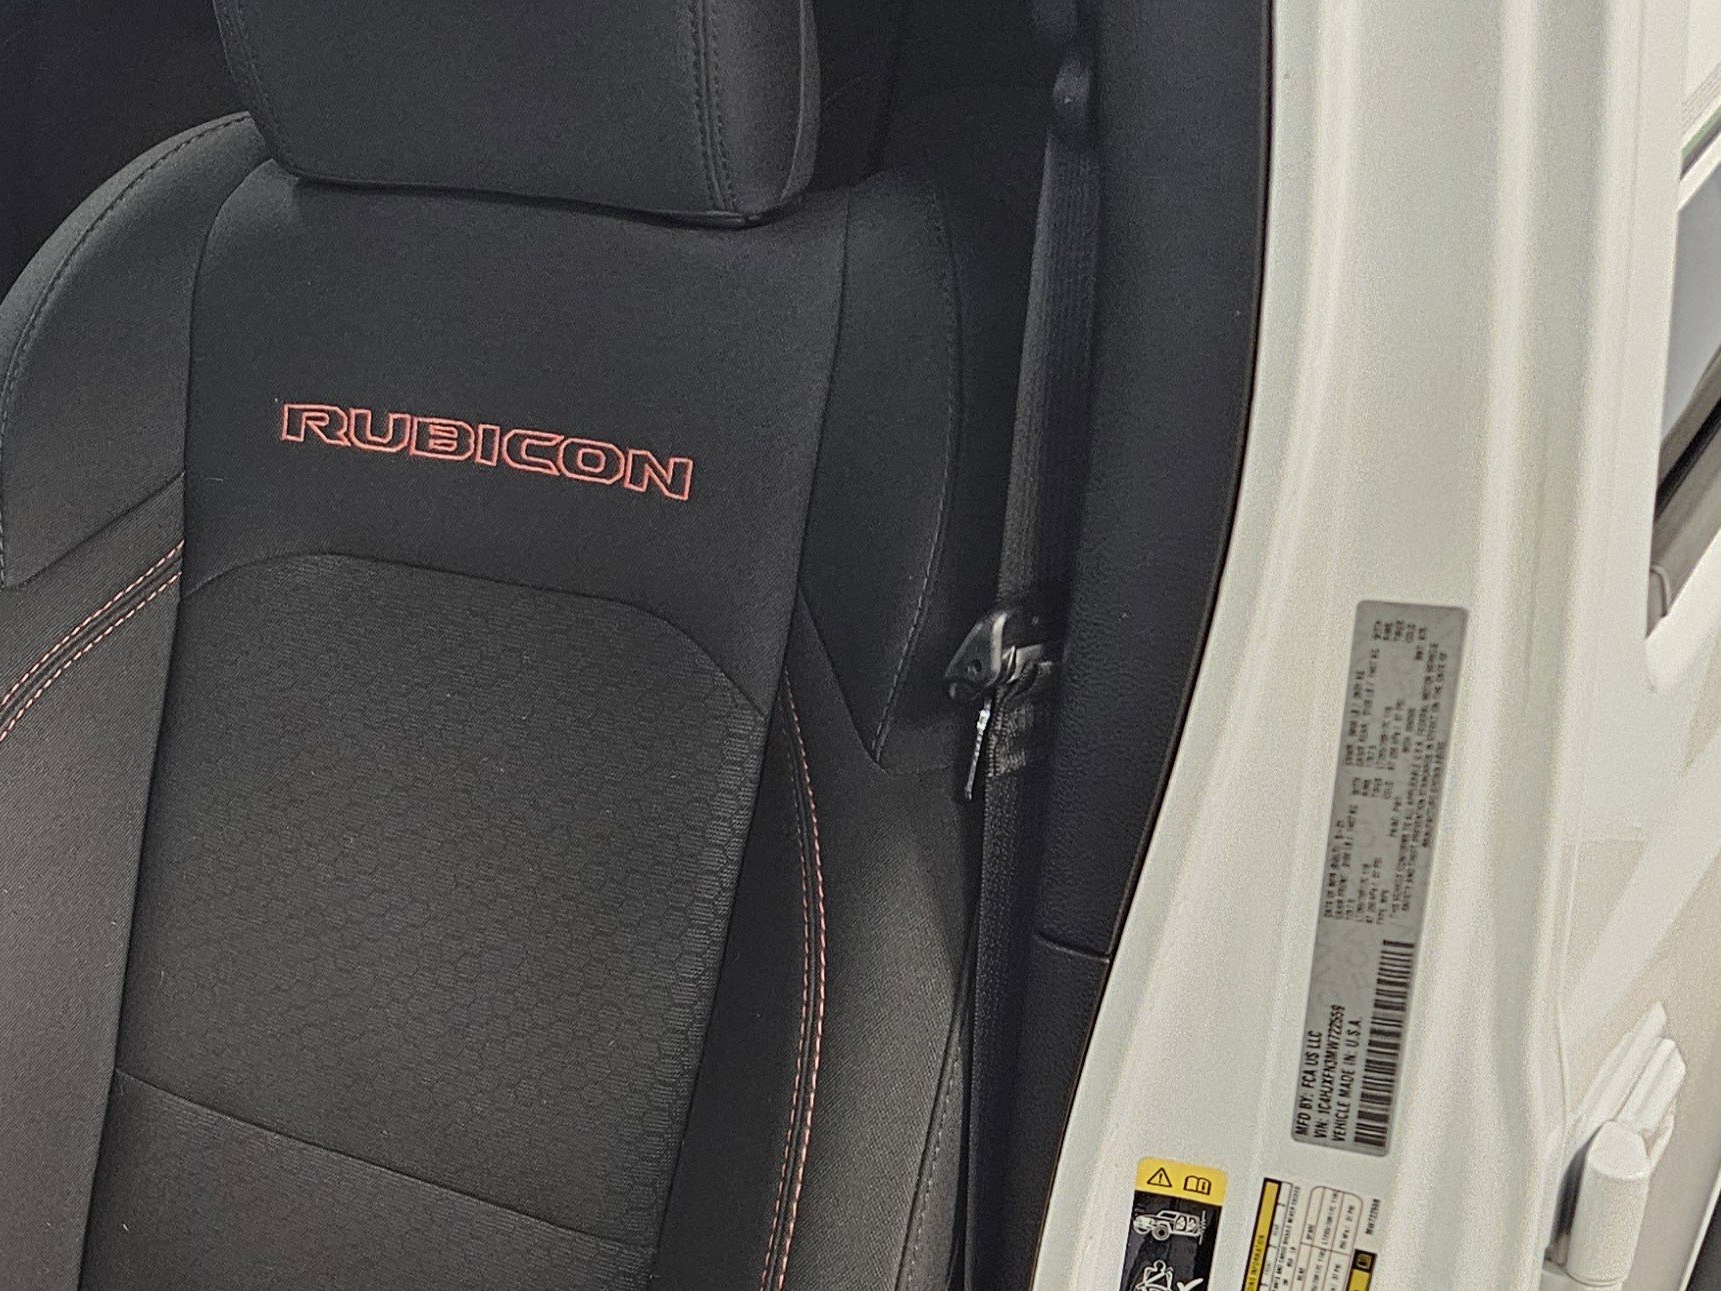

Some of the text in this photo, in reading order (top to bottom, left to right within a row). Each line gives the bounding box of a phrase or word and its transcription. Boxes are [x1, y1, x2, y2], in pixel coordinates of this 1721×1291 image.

[281, 403, 694, 501] RUBICON
[1306, 1029, 1322, 1049] LLC
[1303, 1050, 1319, 1066] US
[1300, 1067, 1317, 1089] FCA
[1339, 1069, 1355, 1098] MADE
[1296, 1112, 1311, 1136] MFD
[1333, 1101, 1350, 1142] VEHICLE
